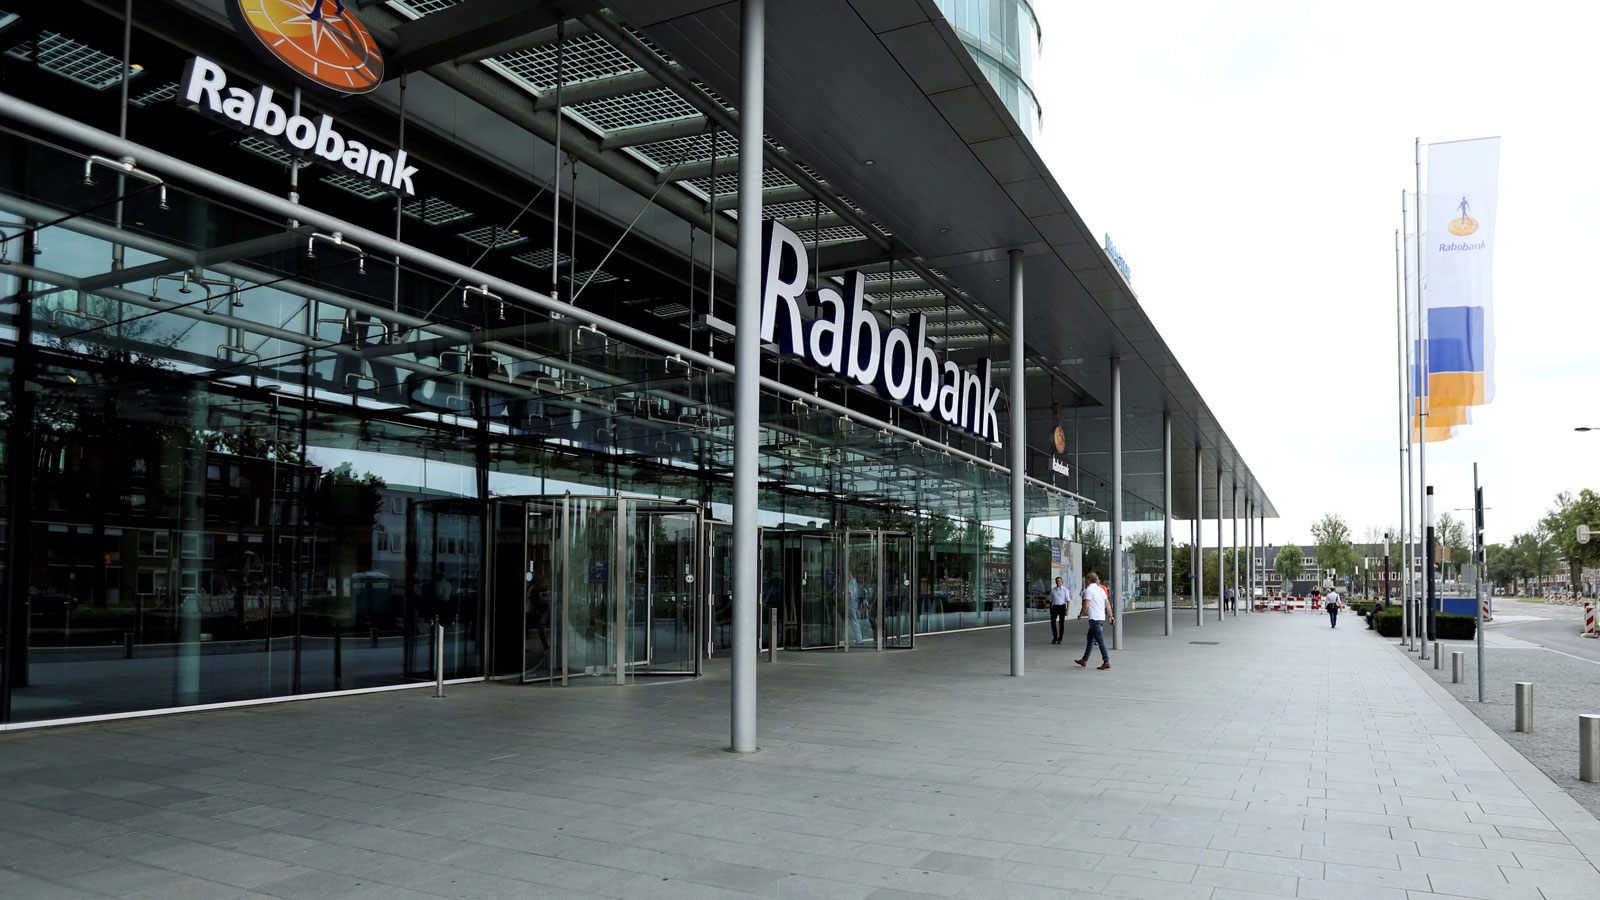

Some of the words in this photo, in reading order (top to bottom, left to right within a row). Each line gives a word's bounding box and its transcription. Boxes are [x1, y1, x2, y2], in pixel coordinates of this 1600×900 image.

[186, 55, 419, 196] Rabobank
[1439, 240, 1486, 252] Rabobank
[761, 219, 1001, 442] Rabobank
[1052, 456, 1070, 477] Rabobank
